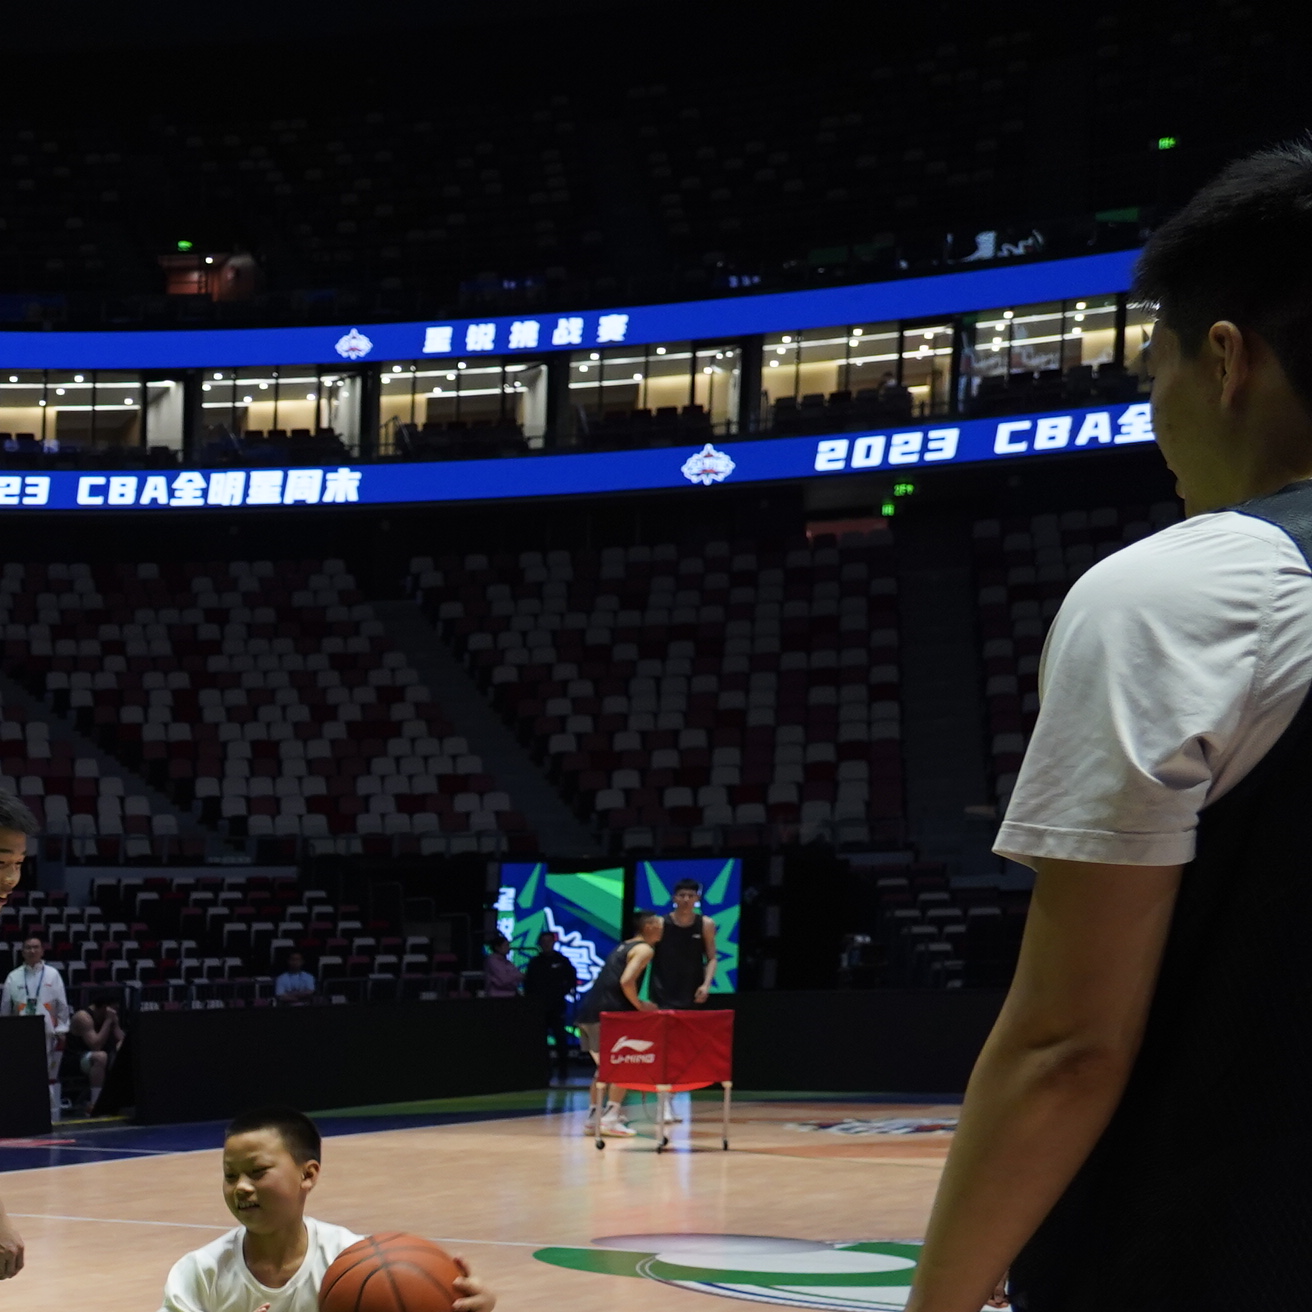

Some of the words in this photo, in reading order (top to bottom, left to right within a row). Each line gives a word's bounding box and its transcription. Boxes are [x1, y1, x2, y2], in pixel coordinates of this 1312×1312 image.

[422, 314, 629, 354] 星锐挑战赛
[814, 428, 960, 472] 2023
[76, 467, 362, 507] CBA全明星周末
